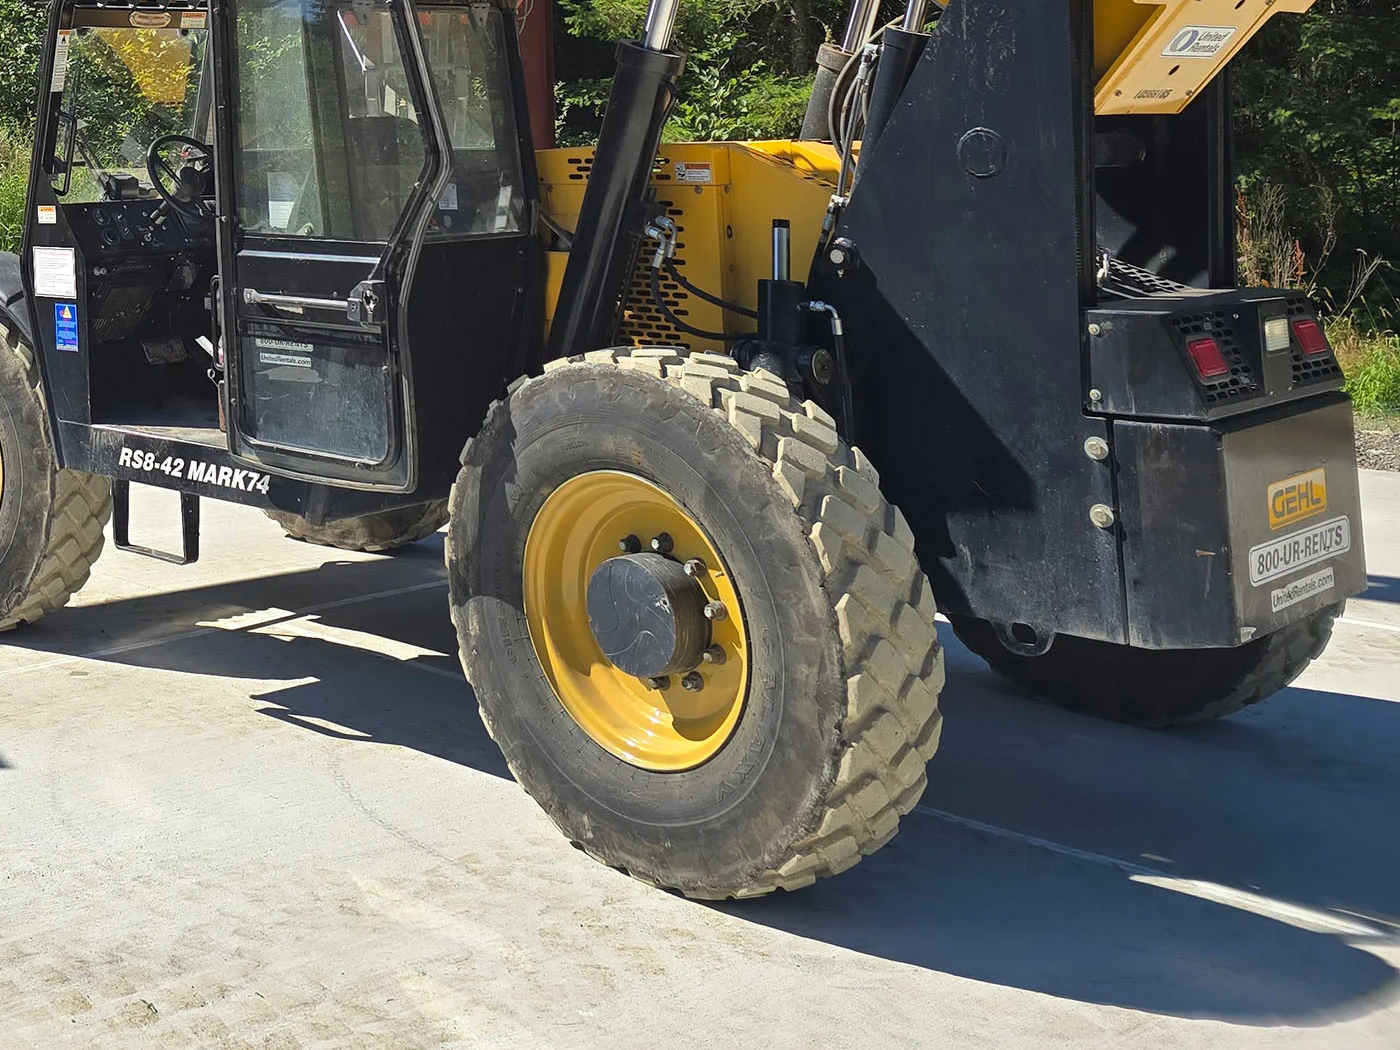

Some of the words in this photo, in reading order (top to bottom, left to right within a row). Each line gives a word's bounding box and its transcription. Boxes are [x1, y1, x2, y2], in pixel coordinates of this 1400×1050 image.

[1187, 42, 1220, 53] Rentals
[1197, 30, 1231, 42] United
[118, 447, 185, 478] RS8-42
[187, 460, 271, 495] MARK74
[1271, 479, 1322, 519] GEHL
[1257, 524, 1343, 576] 800-UR-RENTS
